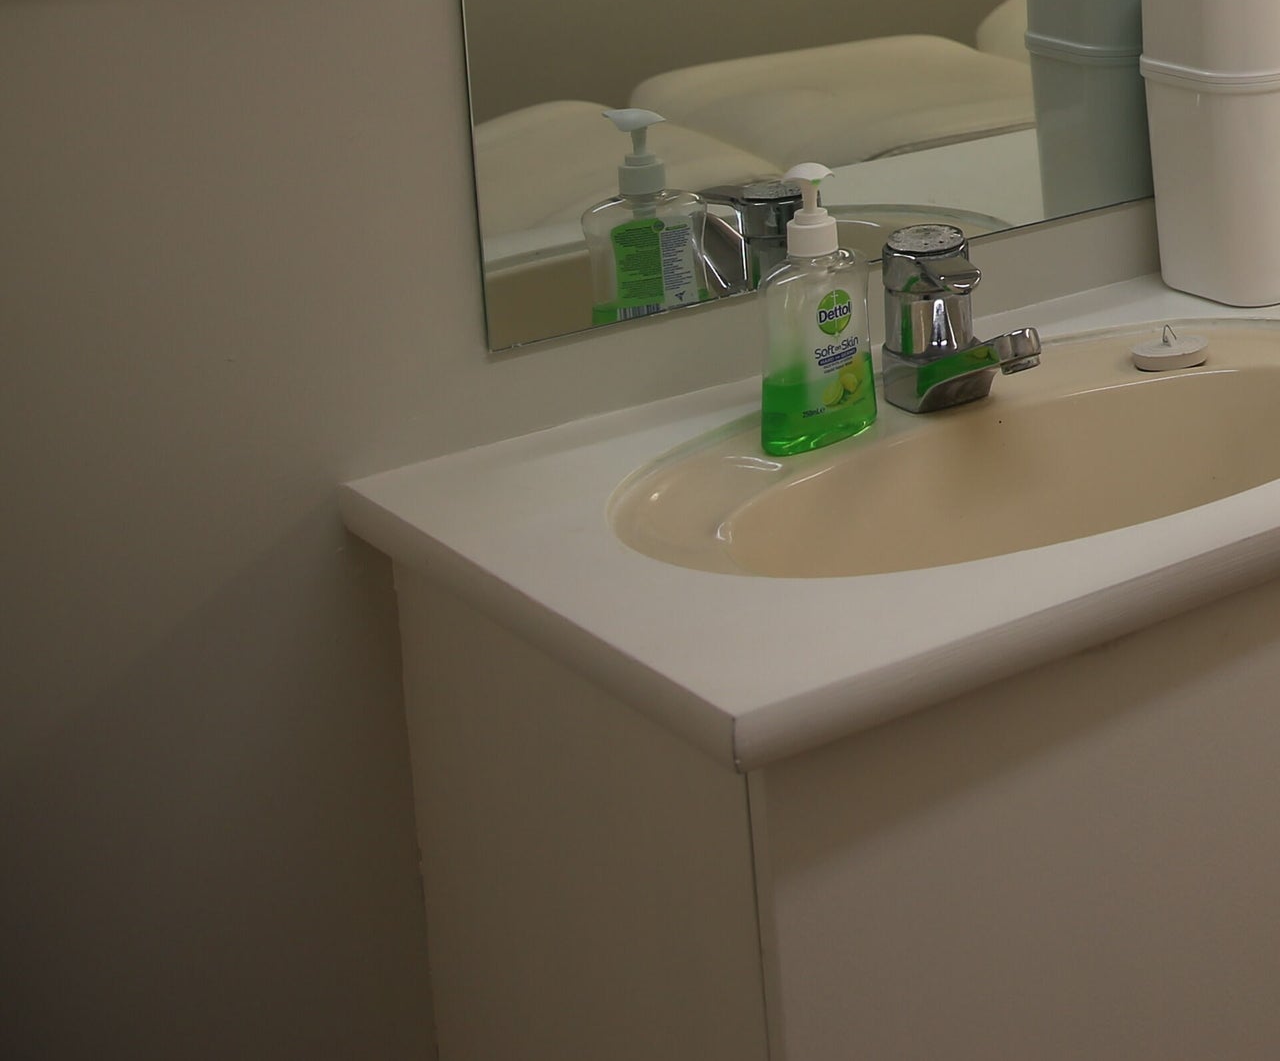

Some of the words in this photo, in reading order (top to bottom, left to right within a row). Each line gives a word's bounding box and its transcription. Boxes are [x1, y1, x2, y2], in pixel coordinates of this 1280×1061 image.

[819, 301, 851, 323] Dettol
[814, 344, 834, 359] Soft
[841, 336, 858, 350] Skin
